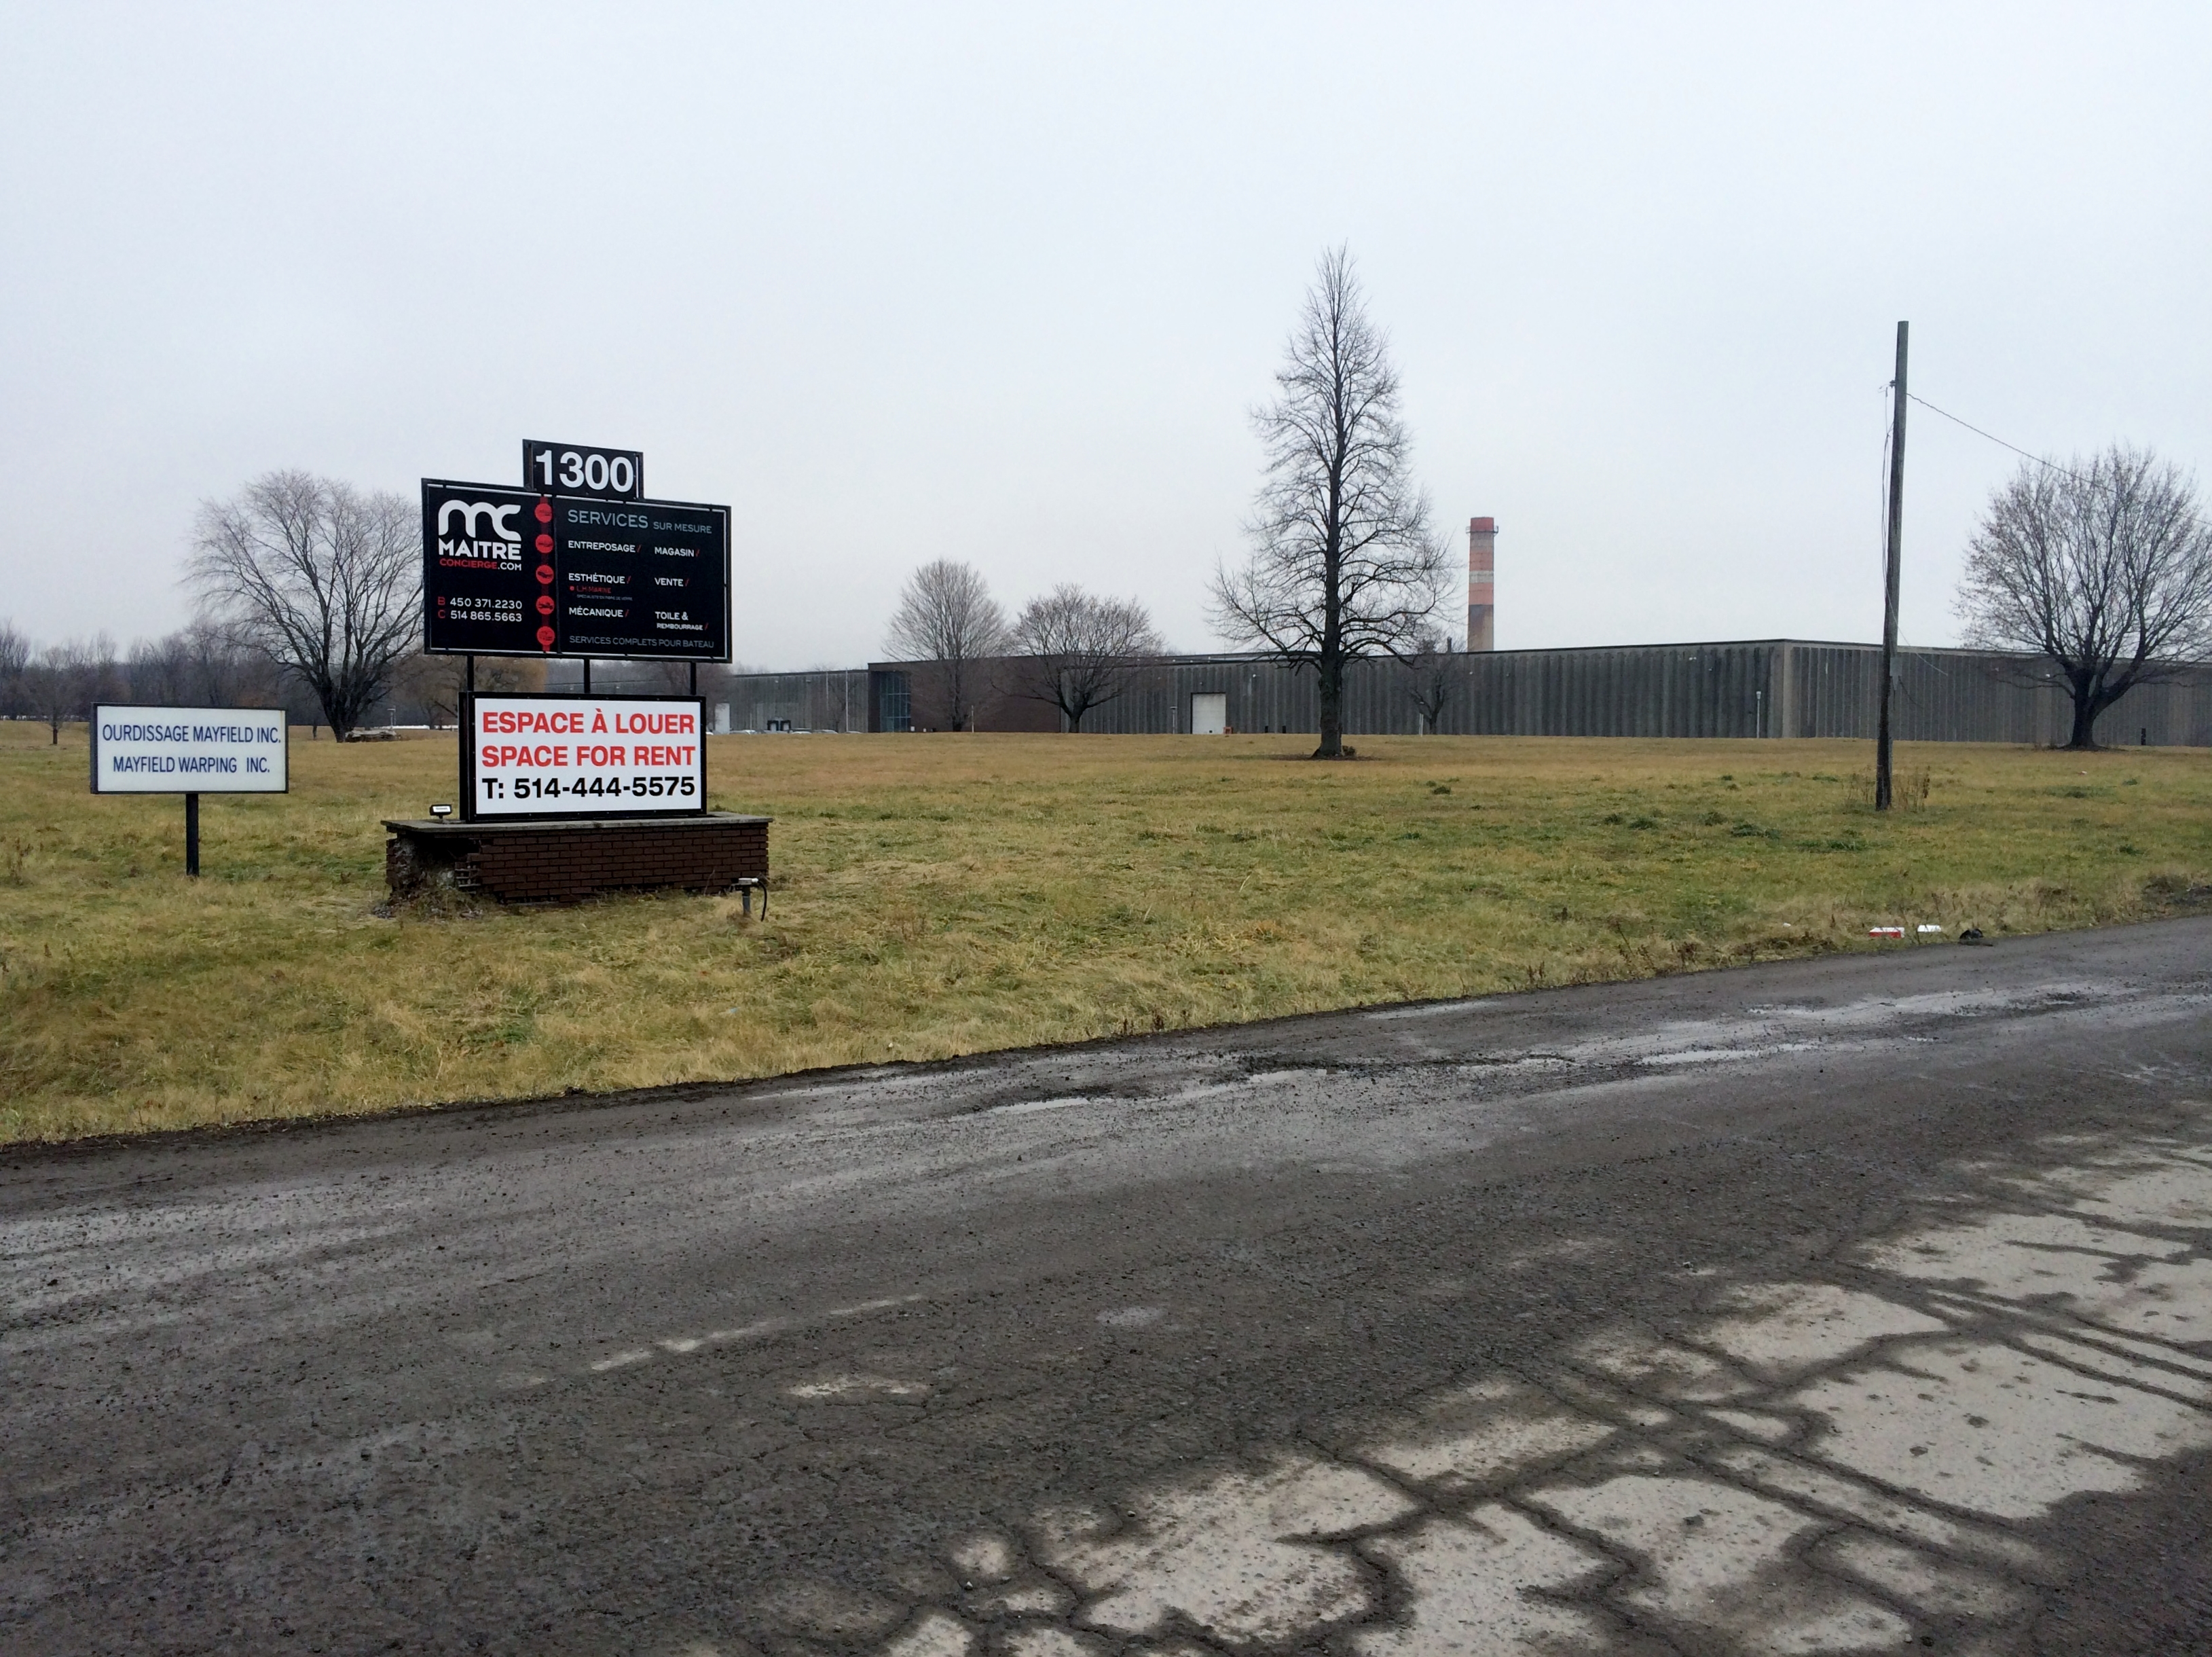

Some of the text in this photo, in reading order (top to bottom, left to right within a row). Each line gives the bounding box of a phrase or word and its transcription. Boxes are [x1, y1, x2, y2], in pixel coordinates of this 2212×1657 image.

[536, 450, 634, 492] 1300
[568, 509, 712, 534] SERVICES SUR MESURE
[439, 538, 521, 560] MAITRE
[568, 540, 636, 553] ENTREPOSAGE
[655, 547, 695, 557] MAGASIN
[440, 558, 522, 571] CONCIERGE.COM
[568, 572, 625, 584] ESTHÉTIQUE
[655, 577, 684, 587] VENTE
[438, 597, 522, 609] B 450 371.2230
[438, 610, 522, 622] C 514 865.5663
[568, 606, 623, 617] MÉCANIQUE
[655, 611, 688, 621] TOILE &
[569, 636, 714, 648] SERVICES COMPLETS POUR BATEAU
[483, 708, 695, 734] ESPACE À LOUER
[103, 724, 281, 743] OURDISSAGE MAYFIELD INC.
[482, 746, 696, 767] SPACE FOR RENT
[113, 756, 270, 773] MAYFIELD WARPING INC.
[482, 776, 695, 799] T: 514-444-5575
